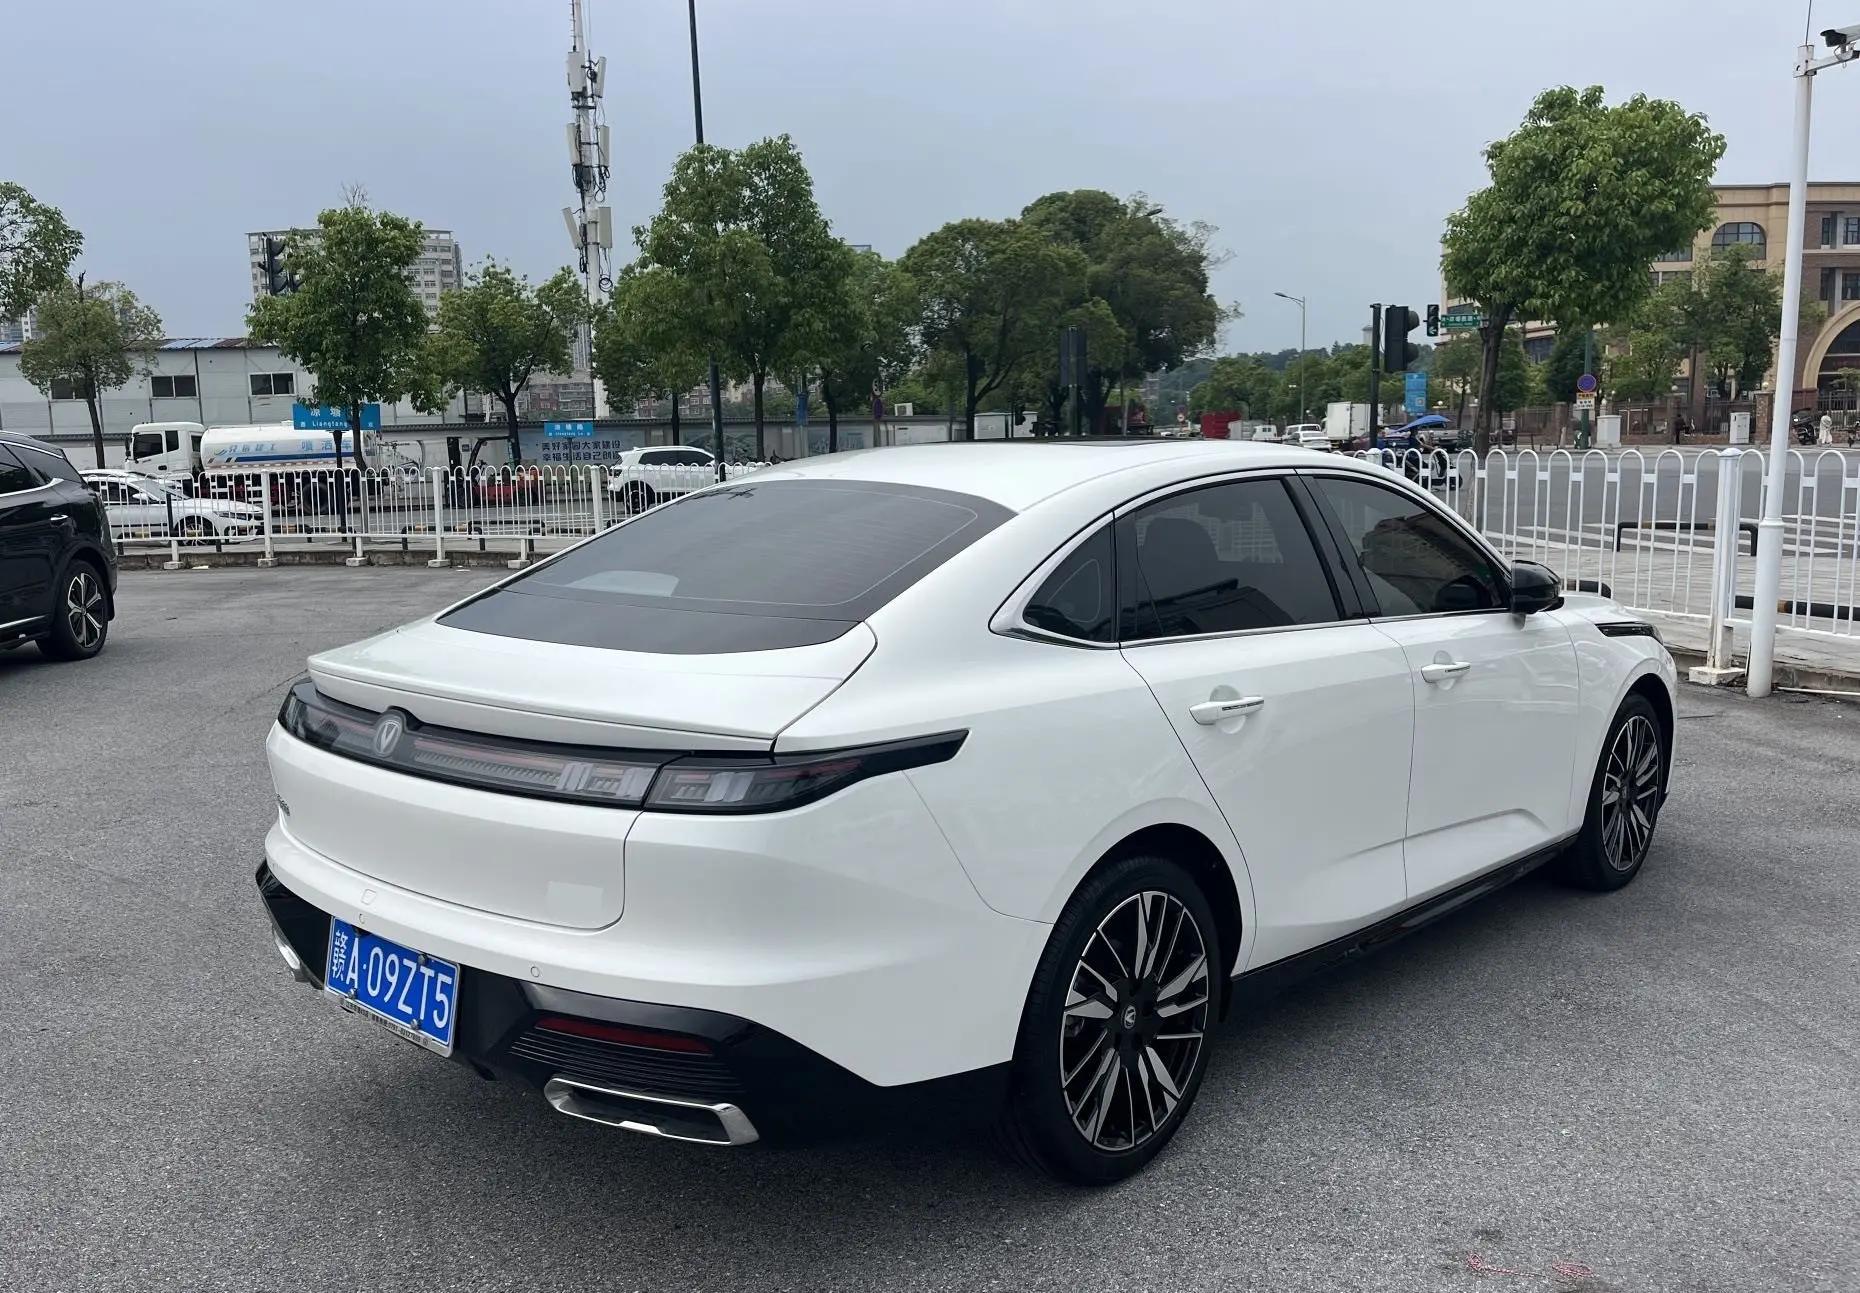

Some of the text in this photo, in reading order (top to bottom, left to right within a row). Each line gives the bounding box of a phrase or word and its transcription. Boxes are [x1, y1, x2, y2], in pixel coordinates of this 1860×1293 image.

[312, 420, 348, 428] Liangtang
[542, 440, 620, 451] 美好家园大家建设
